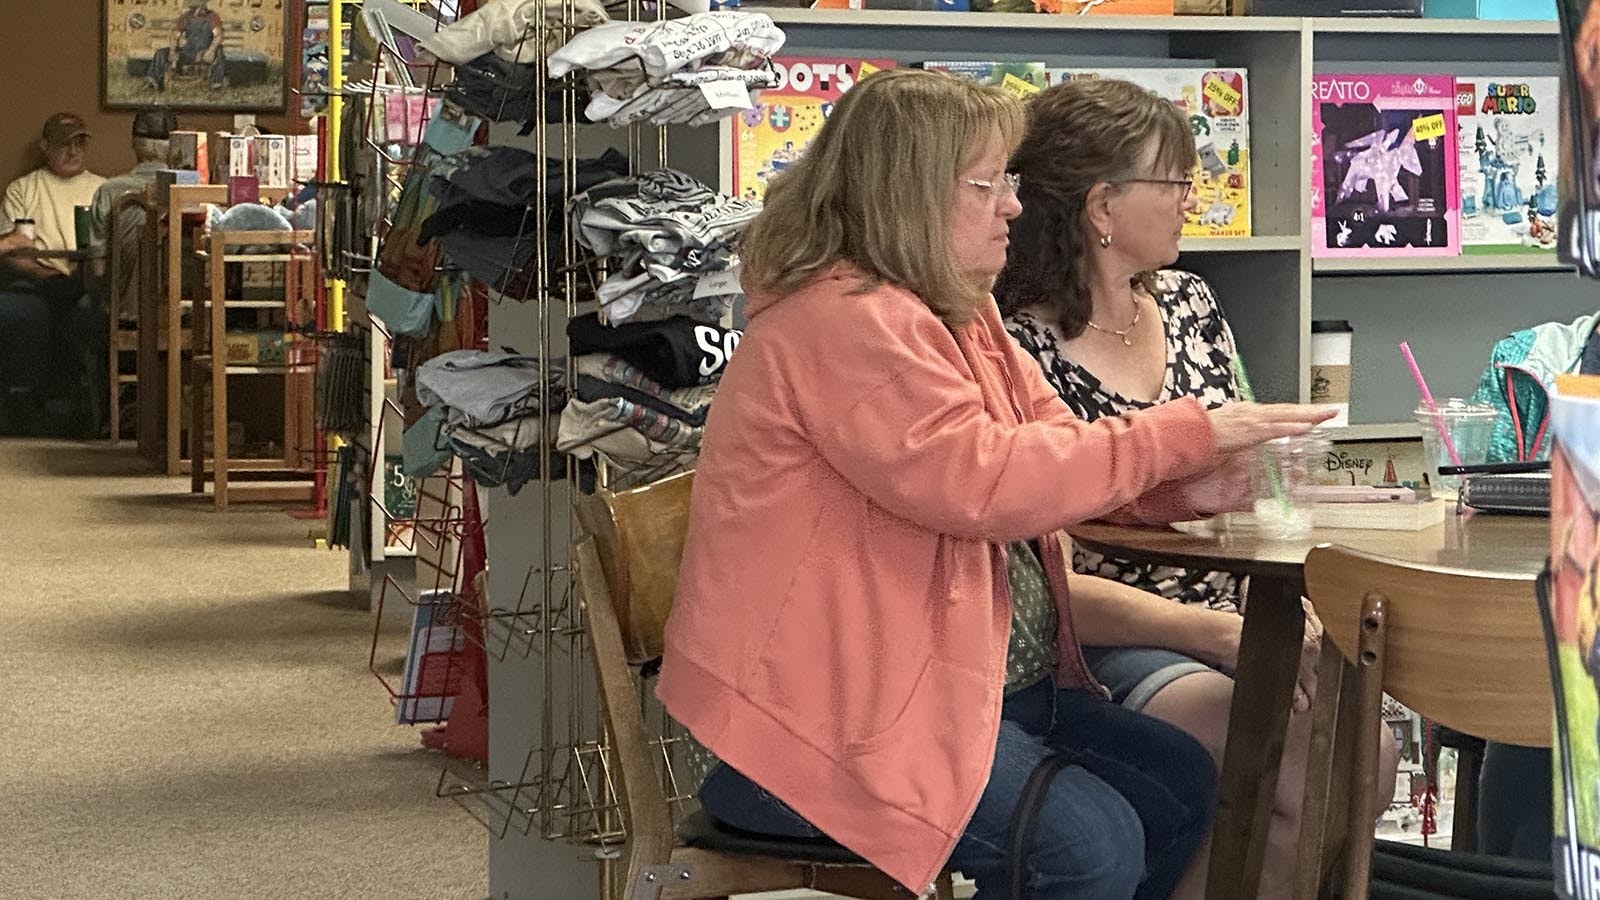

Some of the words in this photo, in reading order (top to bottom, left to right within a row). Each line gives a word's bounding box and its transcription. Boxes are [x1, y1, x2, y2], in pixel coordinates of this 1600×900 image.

[774, 62, 853, 93] DOTS
[1487, 82, 1530, 97] SUPER
[1224, 93, 1236, 105] OFF
[1481, 95, 1537, 115] MARIO
[1415, 123, 1430, 133] 40%
[1431, 120, 1443, 130] OFF
